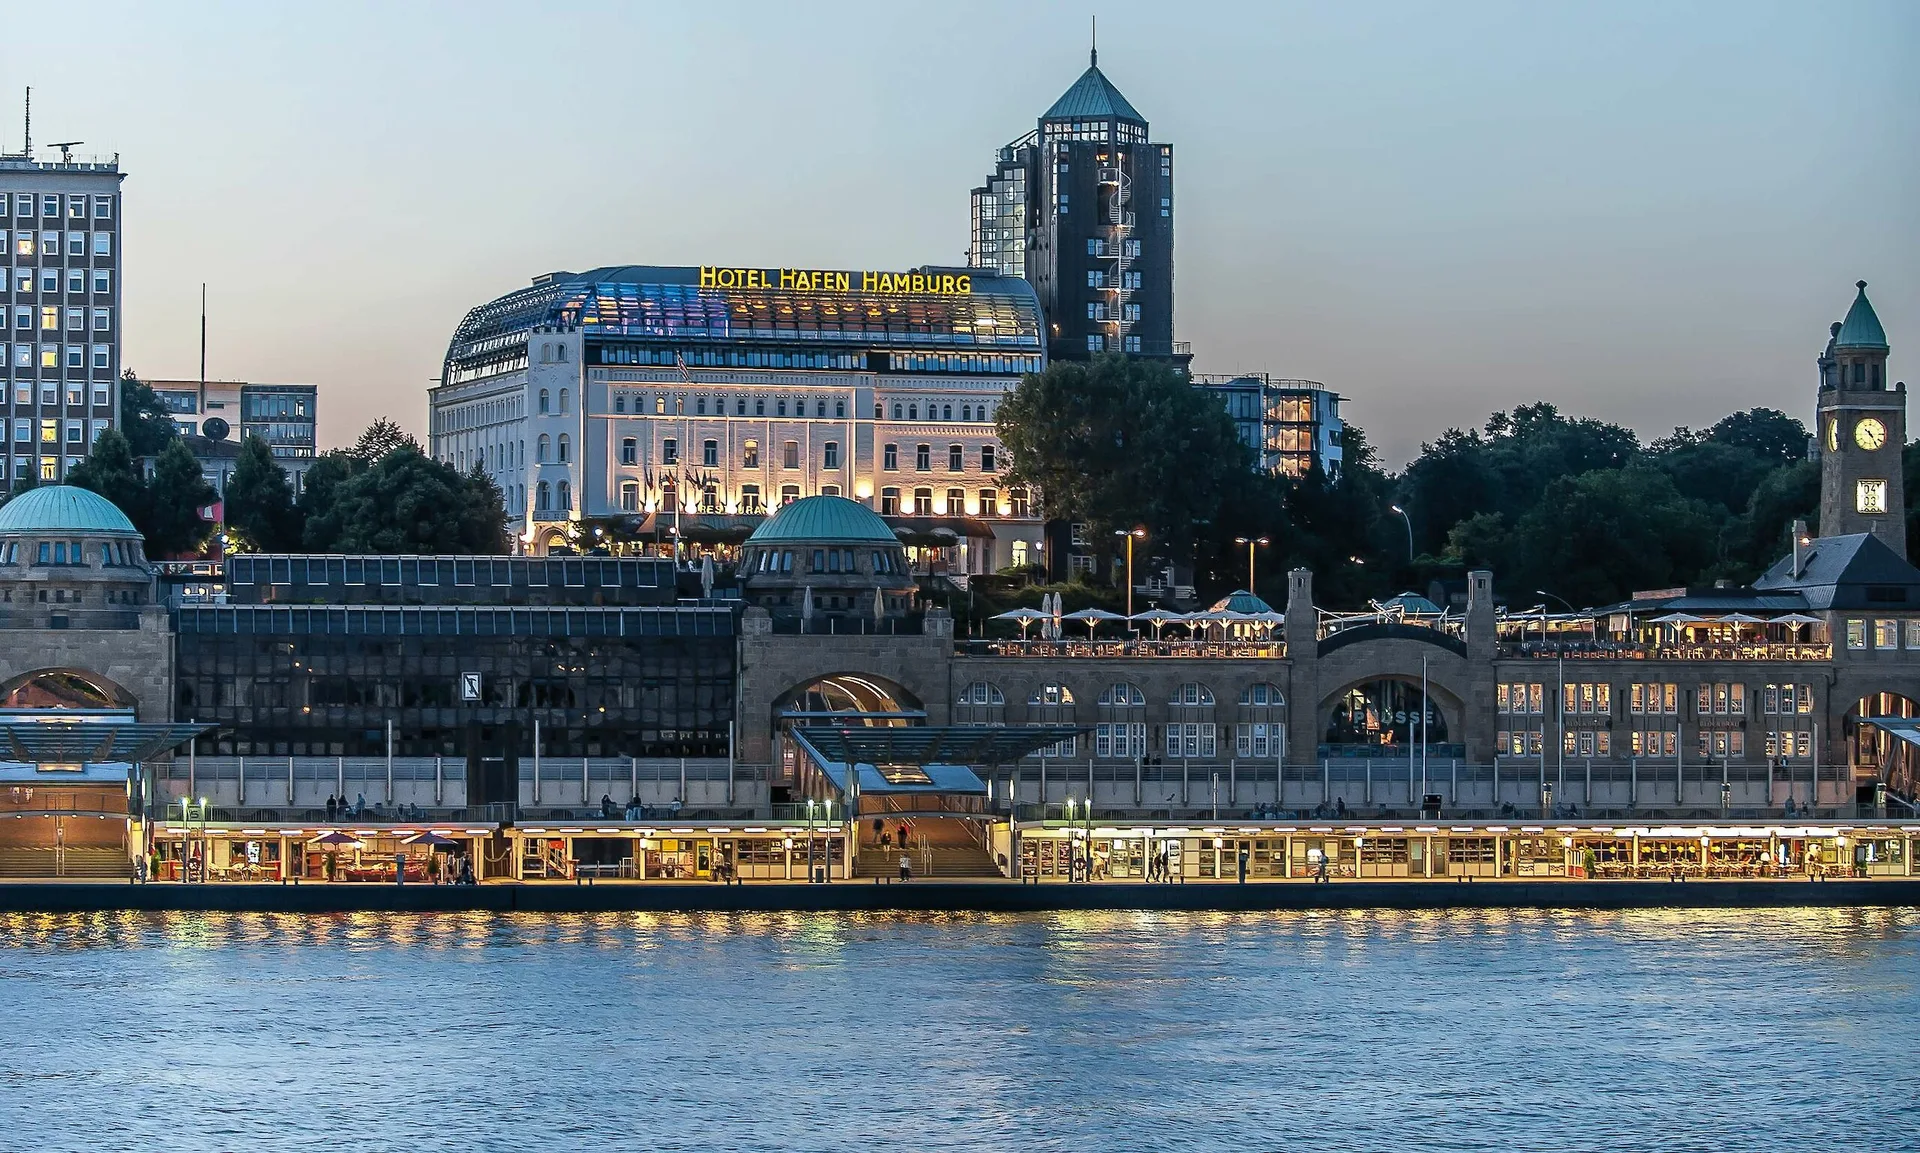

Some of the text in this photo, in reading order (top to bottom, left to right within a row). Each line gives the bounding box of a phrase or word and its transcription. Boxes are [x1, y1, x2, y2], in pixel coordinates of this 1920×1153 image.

[700, 265, 971, 295] HOTEL HAFEN HAMBURG
[1864, 485, 1876, 494] 04
[700, 505, 777, 515] RESTURAN
